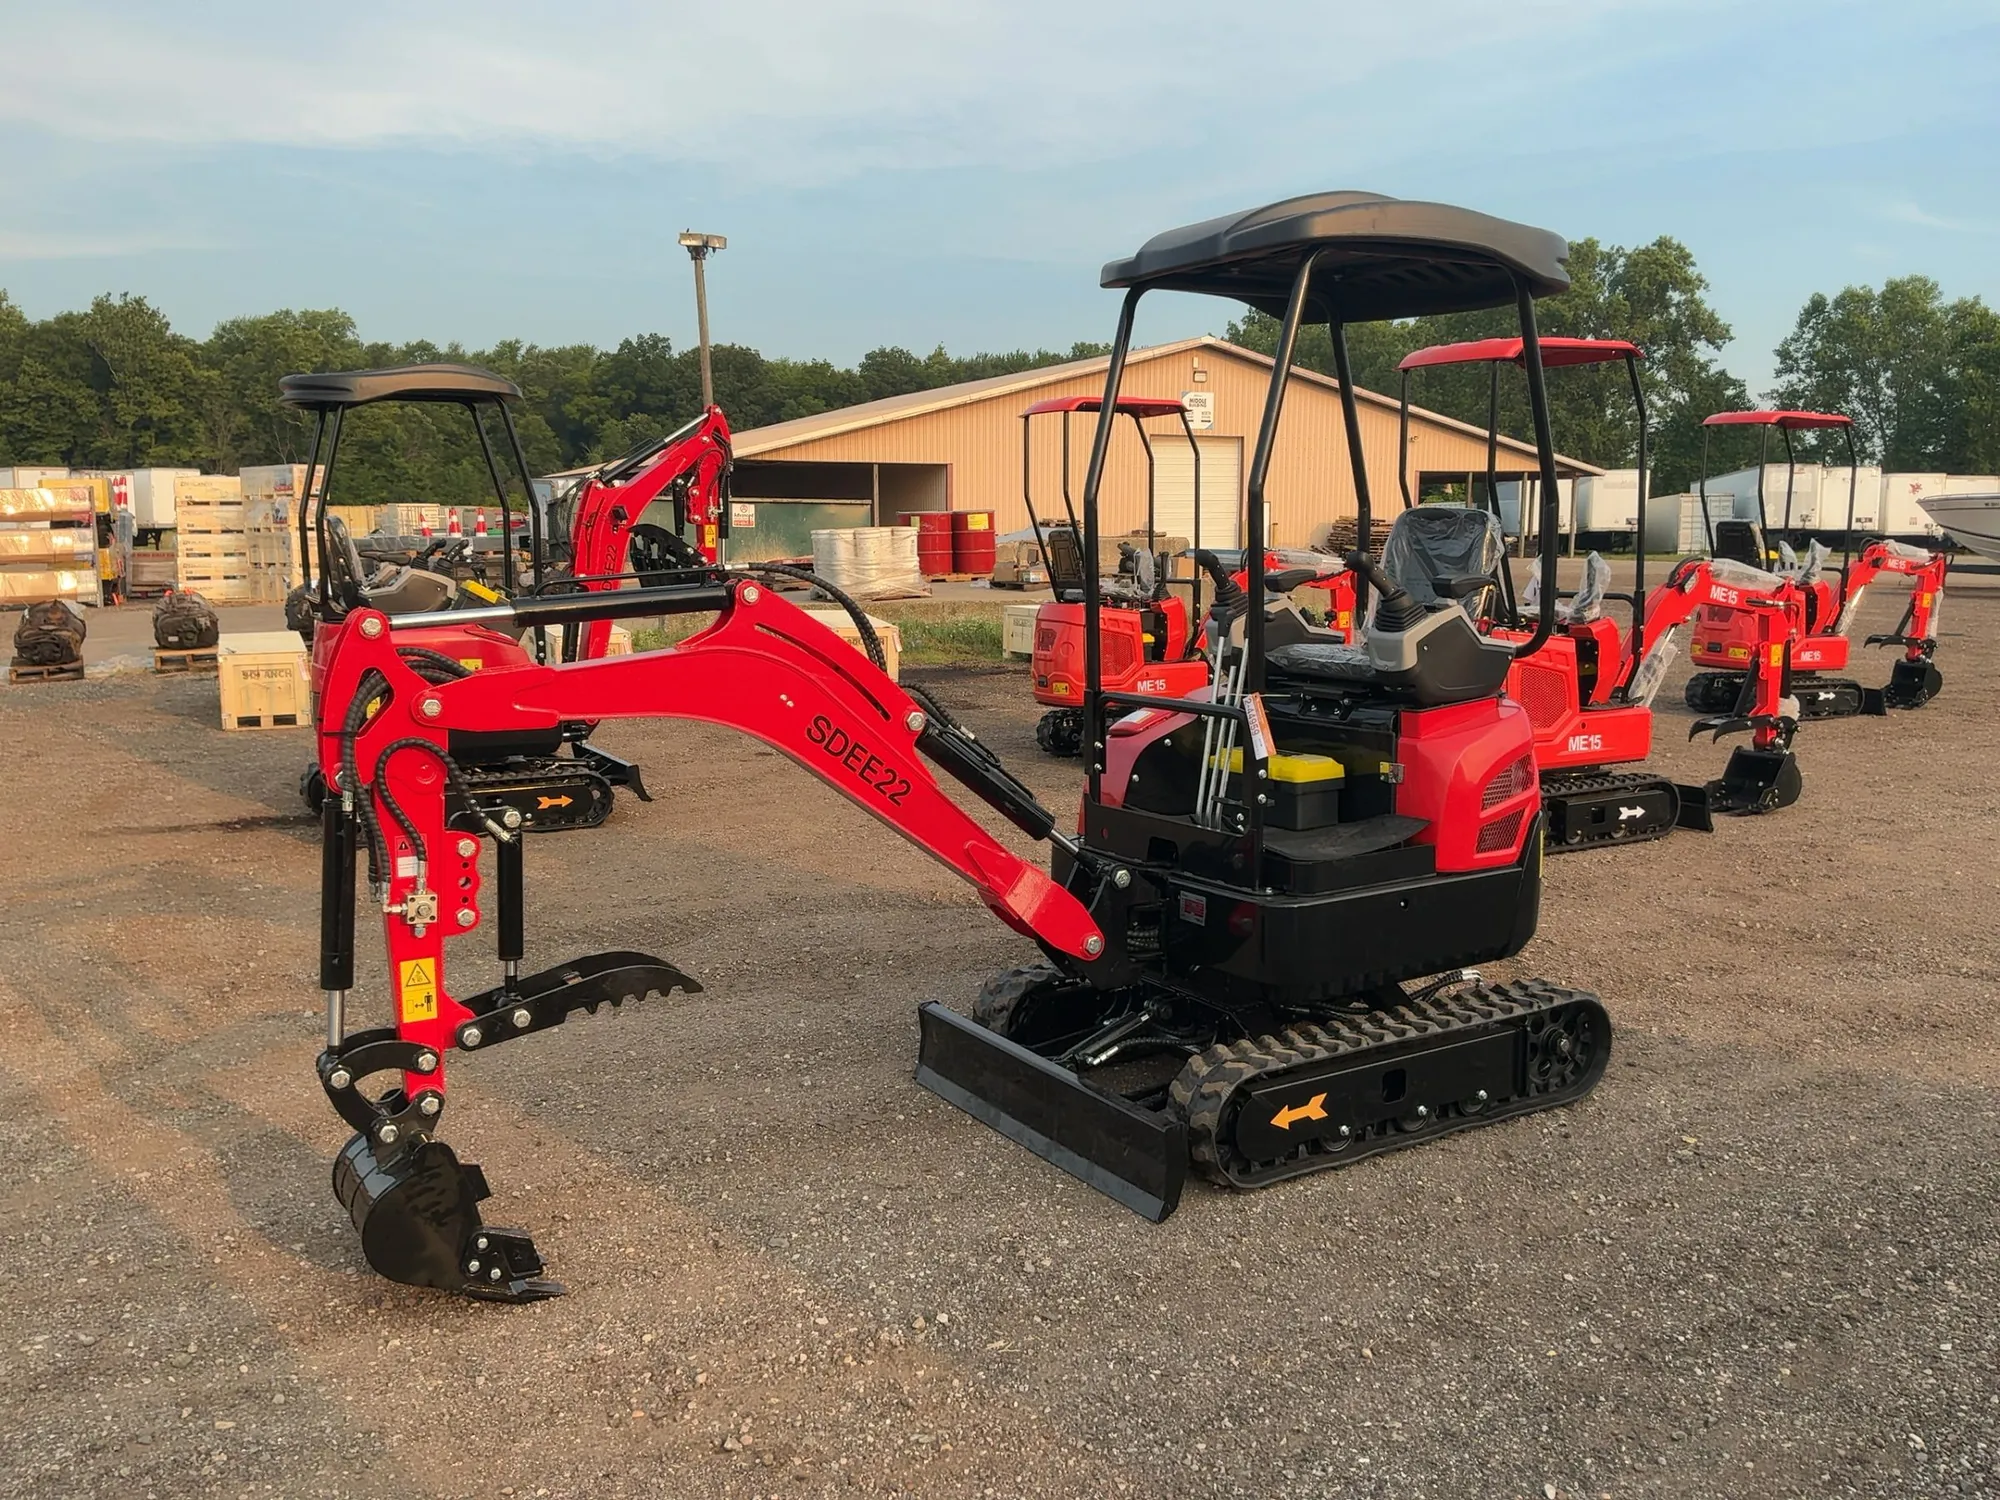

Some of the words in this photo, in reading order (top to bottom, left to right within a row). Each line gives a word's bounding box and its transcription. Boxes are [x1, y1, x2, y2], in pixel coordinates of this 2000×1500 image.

[1887, 558, 1907, 570] ME15
[1709, 584, 1739, 605] ME15
[1800, 650, 1821, 661] ME15
[1137, 679, 1166, 692] ME15
[1568, 734, 1602, 752] ME15
[806, 715, 912, 807] SDEE22
